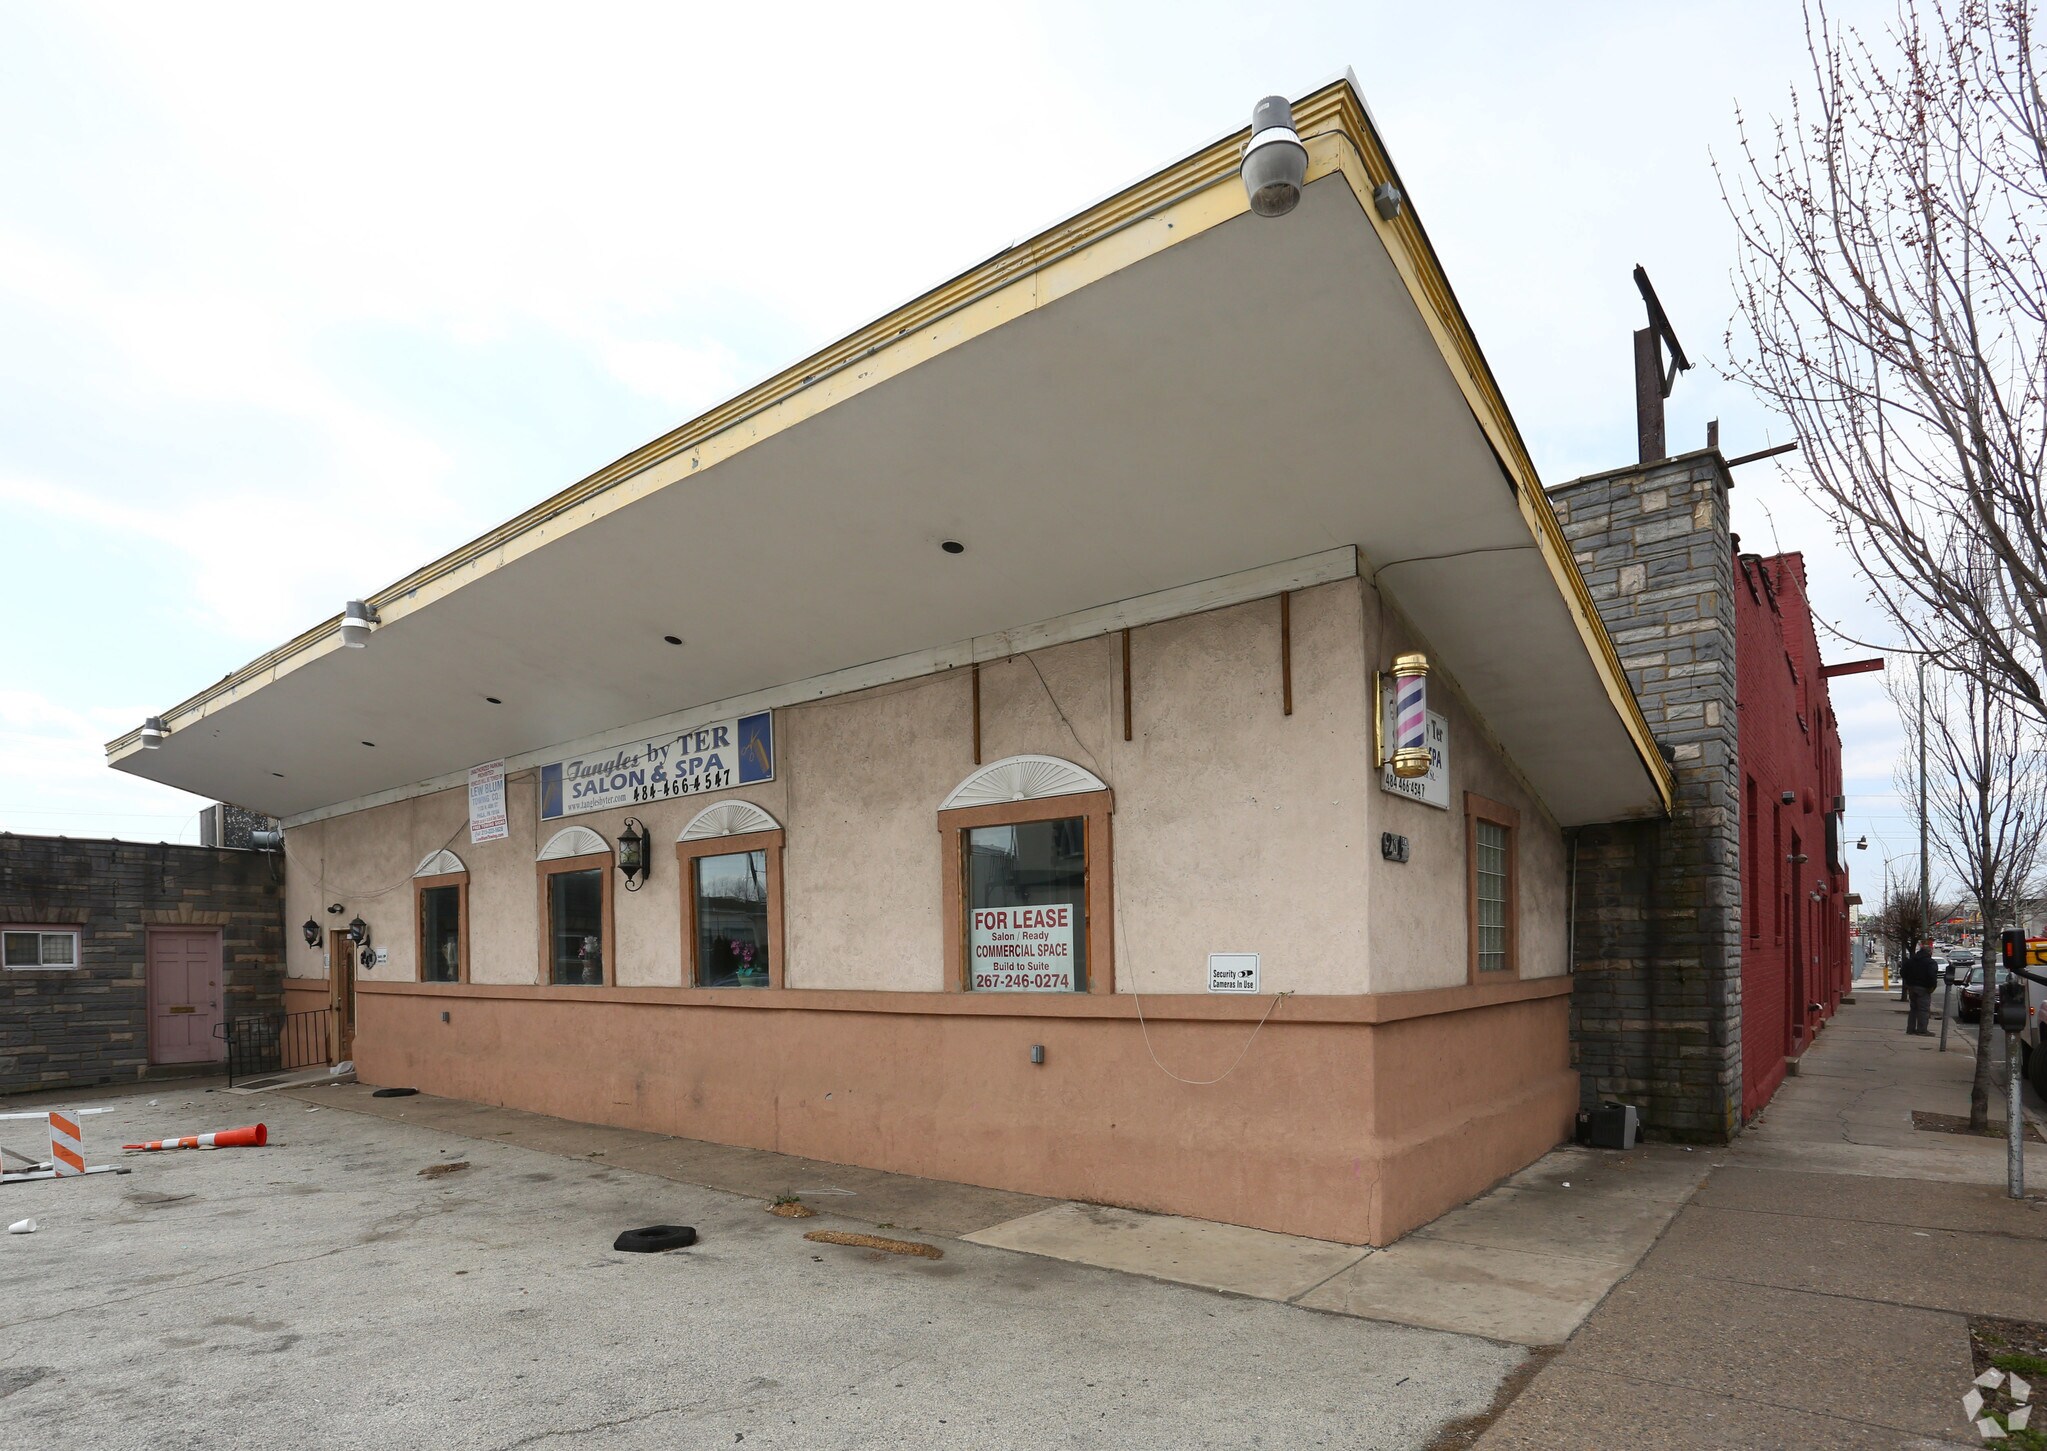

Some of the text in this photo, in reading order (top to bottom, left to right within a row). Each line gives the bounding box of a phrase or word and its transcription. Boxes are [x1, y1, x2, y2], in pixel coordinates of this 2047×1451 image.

[1431, 719, 1443, 743] Ter
[567, 726, 730, 781] Tangles by TER
[572, 753, 724, 799] SALON & SPA
[471, 780, 503, 797] LEW BLUM
[975, 908, 1068, 930] FOR LEASE
[992, 932, 1015, 941] Salon
[1022, 931, 1049, 941] Ready
[976, 943, 1068, 958] COMMERCIAL SPACE
[993, 961, 1050, 971] Build to Suite
[976, 974, 1069, 988] 267-246-0274
[1213, 969, 1236, 979] Security
[1213, 979, 1236, 989] Cameras
[1243, 980, 1254, 989] Use
